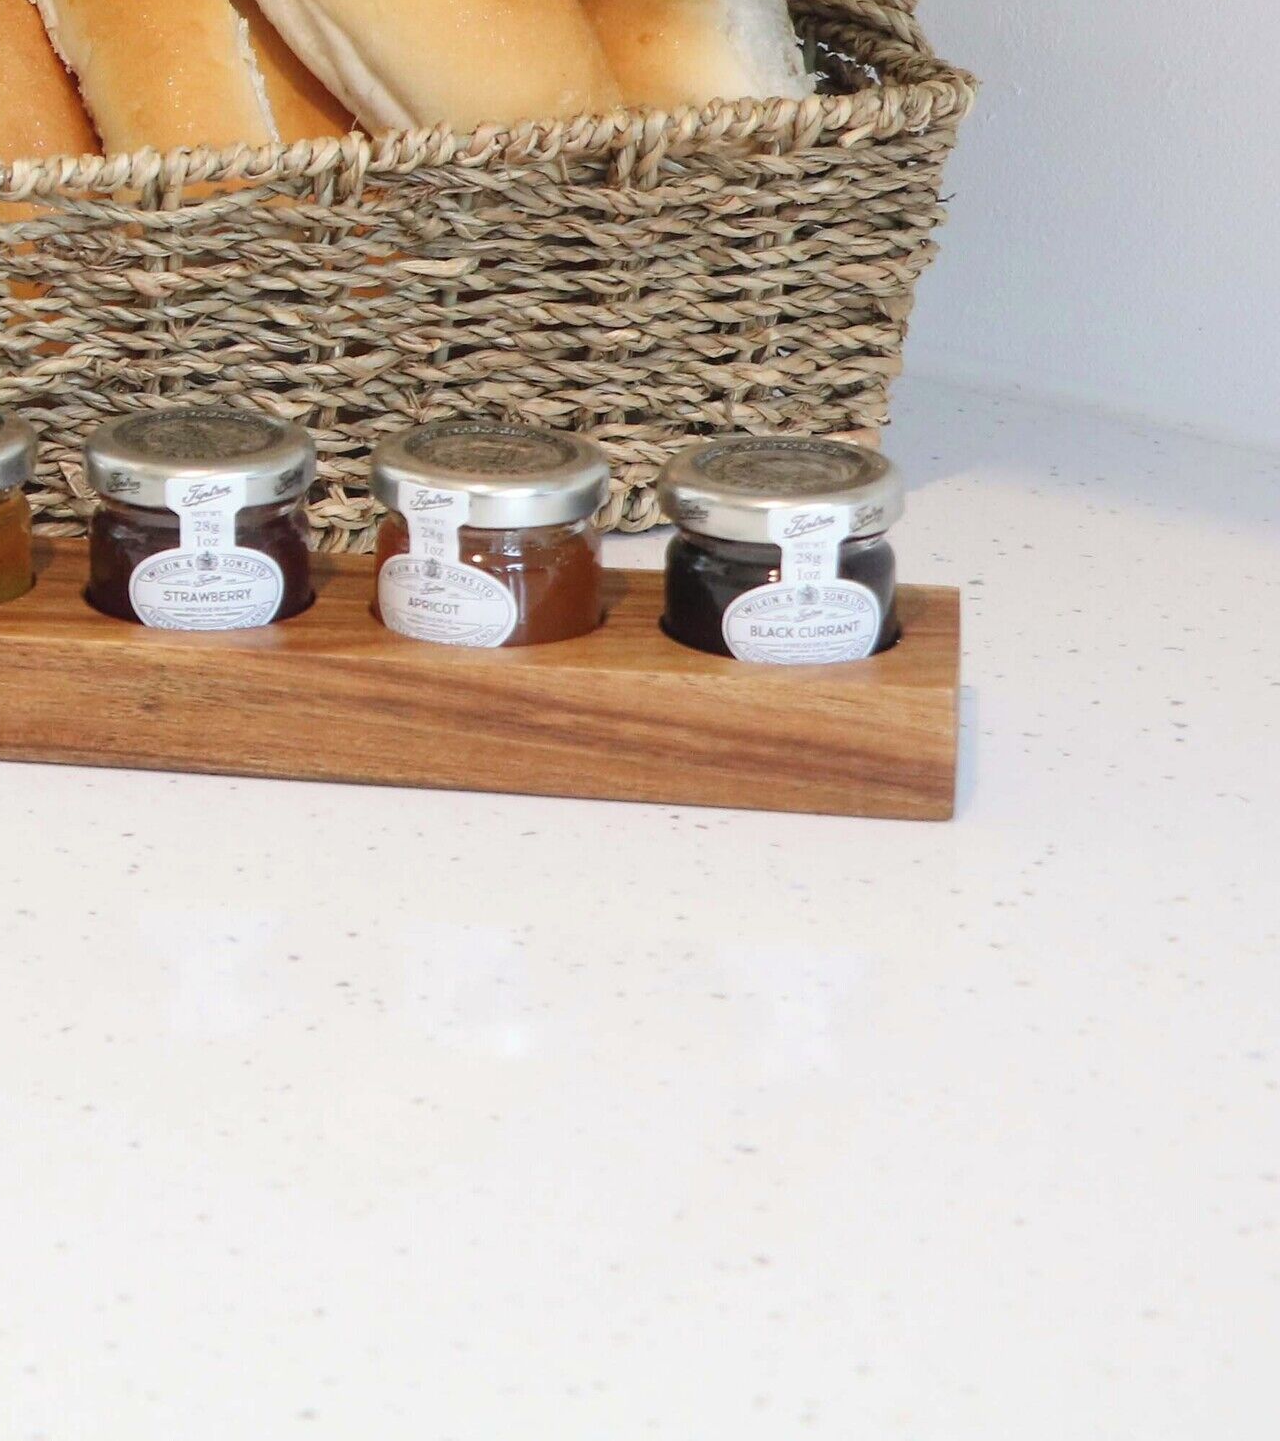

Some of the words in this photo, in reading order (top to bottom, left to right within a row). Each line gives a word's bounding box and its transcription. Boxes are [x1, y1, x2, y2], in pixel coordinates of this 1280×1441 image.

[193, 521, 221, 534] 28g
[793, 552, 823, 567] 28g
[146, 561, 180, 578] WILKIN
[163, 589, 252, 603] STRAWBERRY
[407, 595, 461, 616] APRICOT
[749, 624, 794, 639] BLACK
[798, 620, 861, 639] CURRANT
